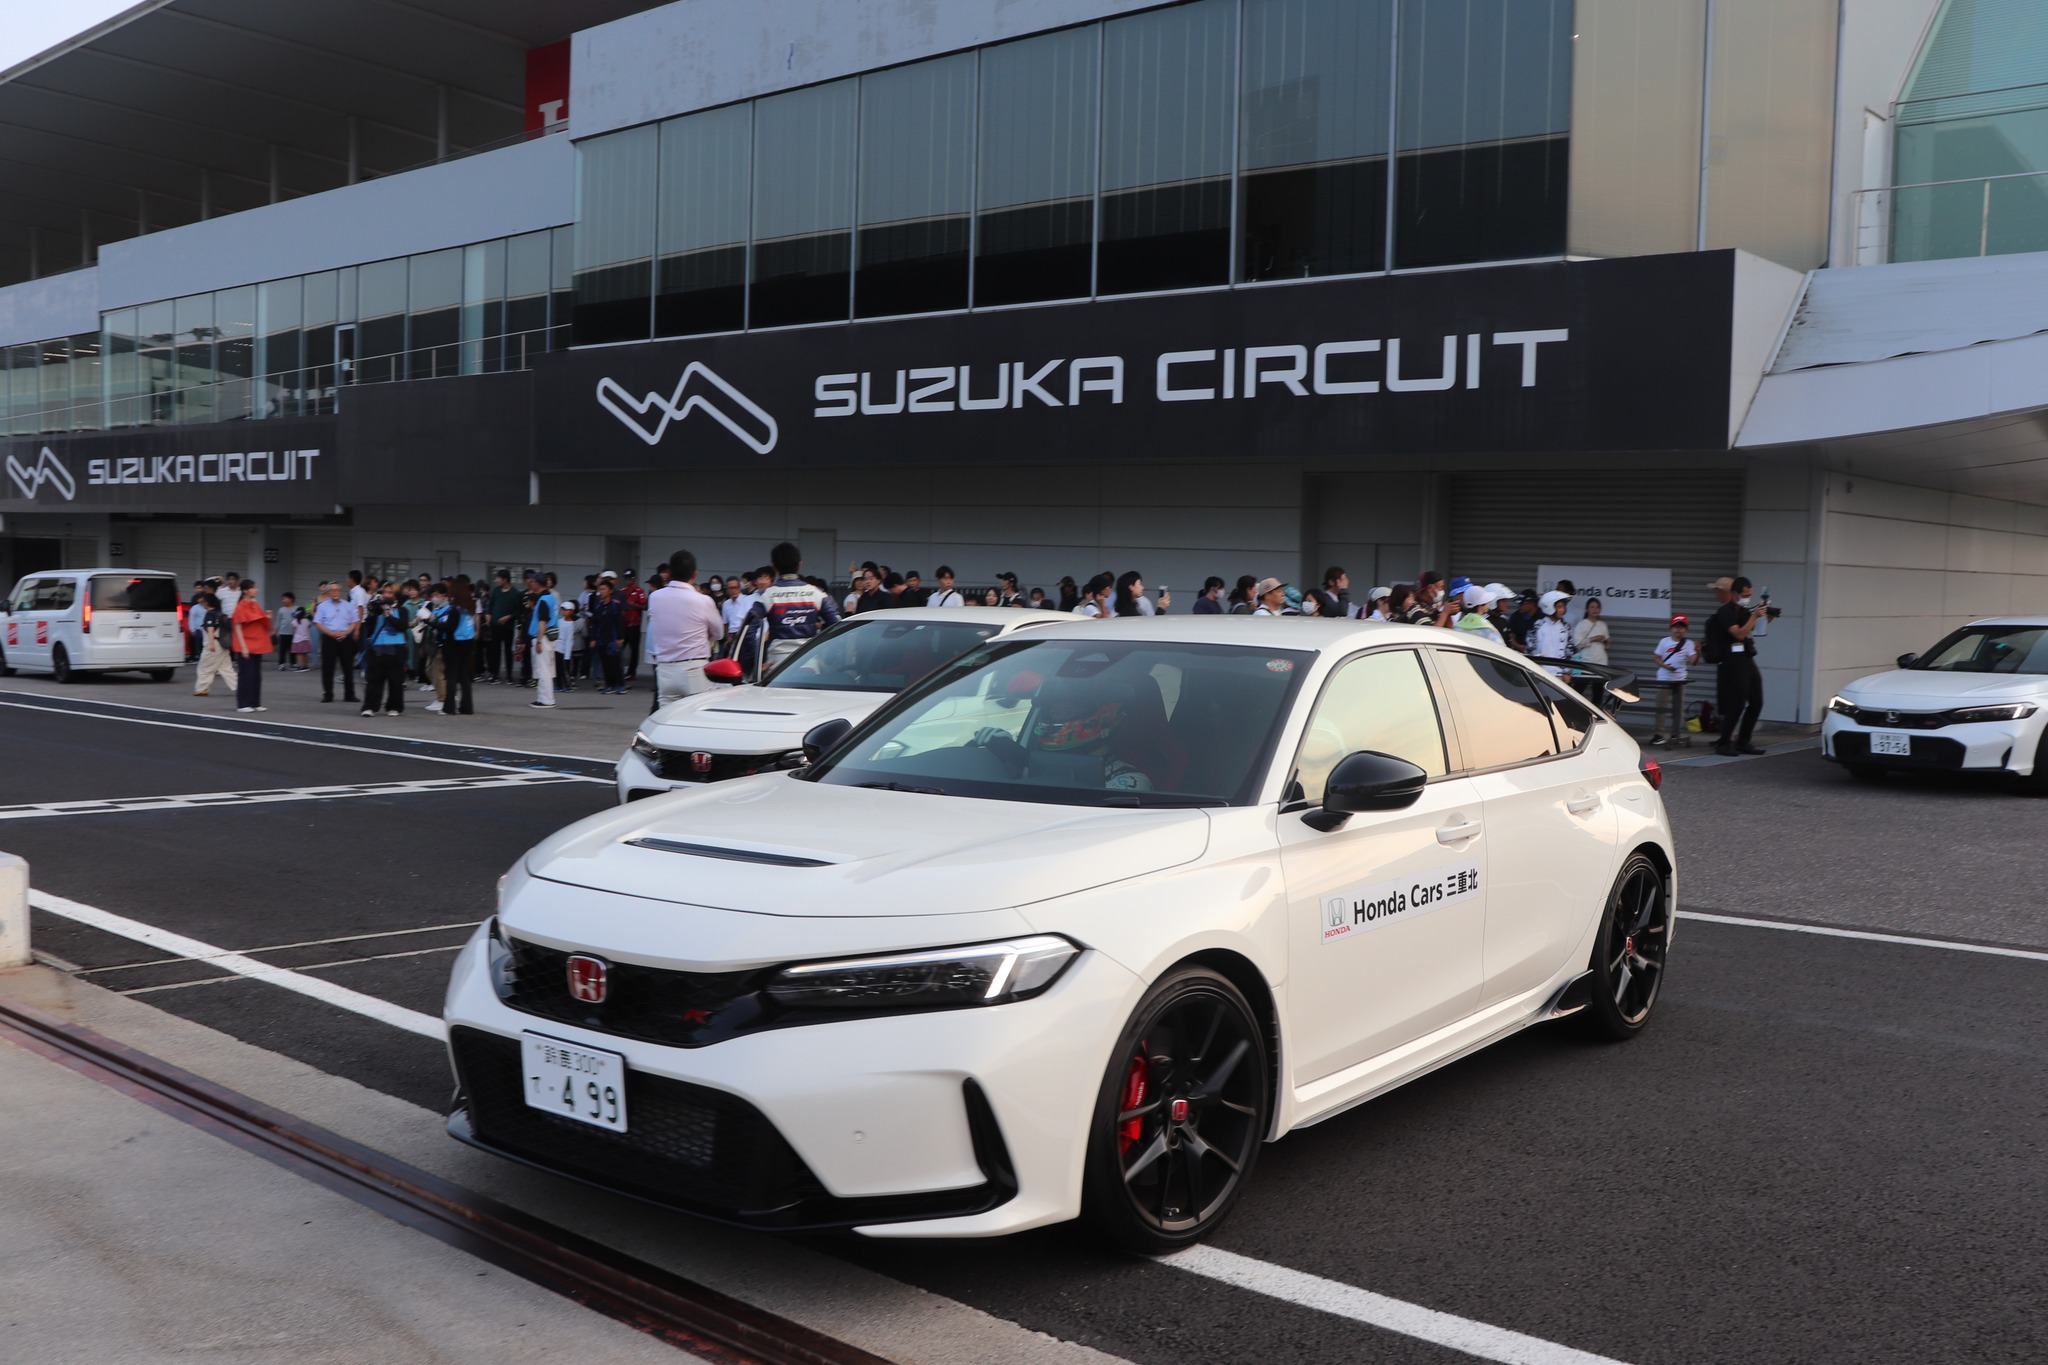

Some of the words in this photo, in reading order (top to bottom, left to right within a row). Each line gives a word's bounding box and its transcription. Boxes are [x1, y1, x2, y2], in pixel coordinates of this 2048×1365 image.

[814, 355, 1124, 418] SUZUKA
[1156, 328, 1569, 402] CIRCUIT
[88, 455, 195, 485] SUZUKA
[198, 449, 320, 483] CIRCUIT
[1606, 586, 1635, 598] Cars
[1354, 890, 1406, 925] Honda
[1410, 883, 1443, 908] Cars
[1447, 868, 1478, 897] 三重北
[1324, 925, 1351, 938] HONDA
